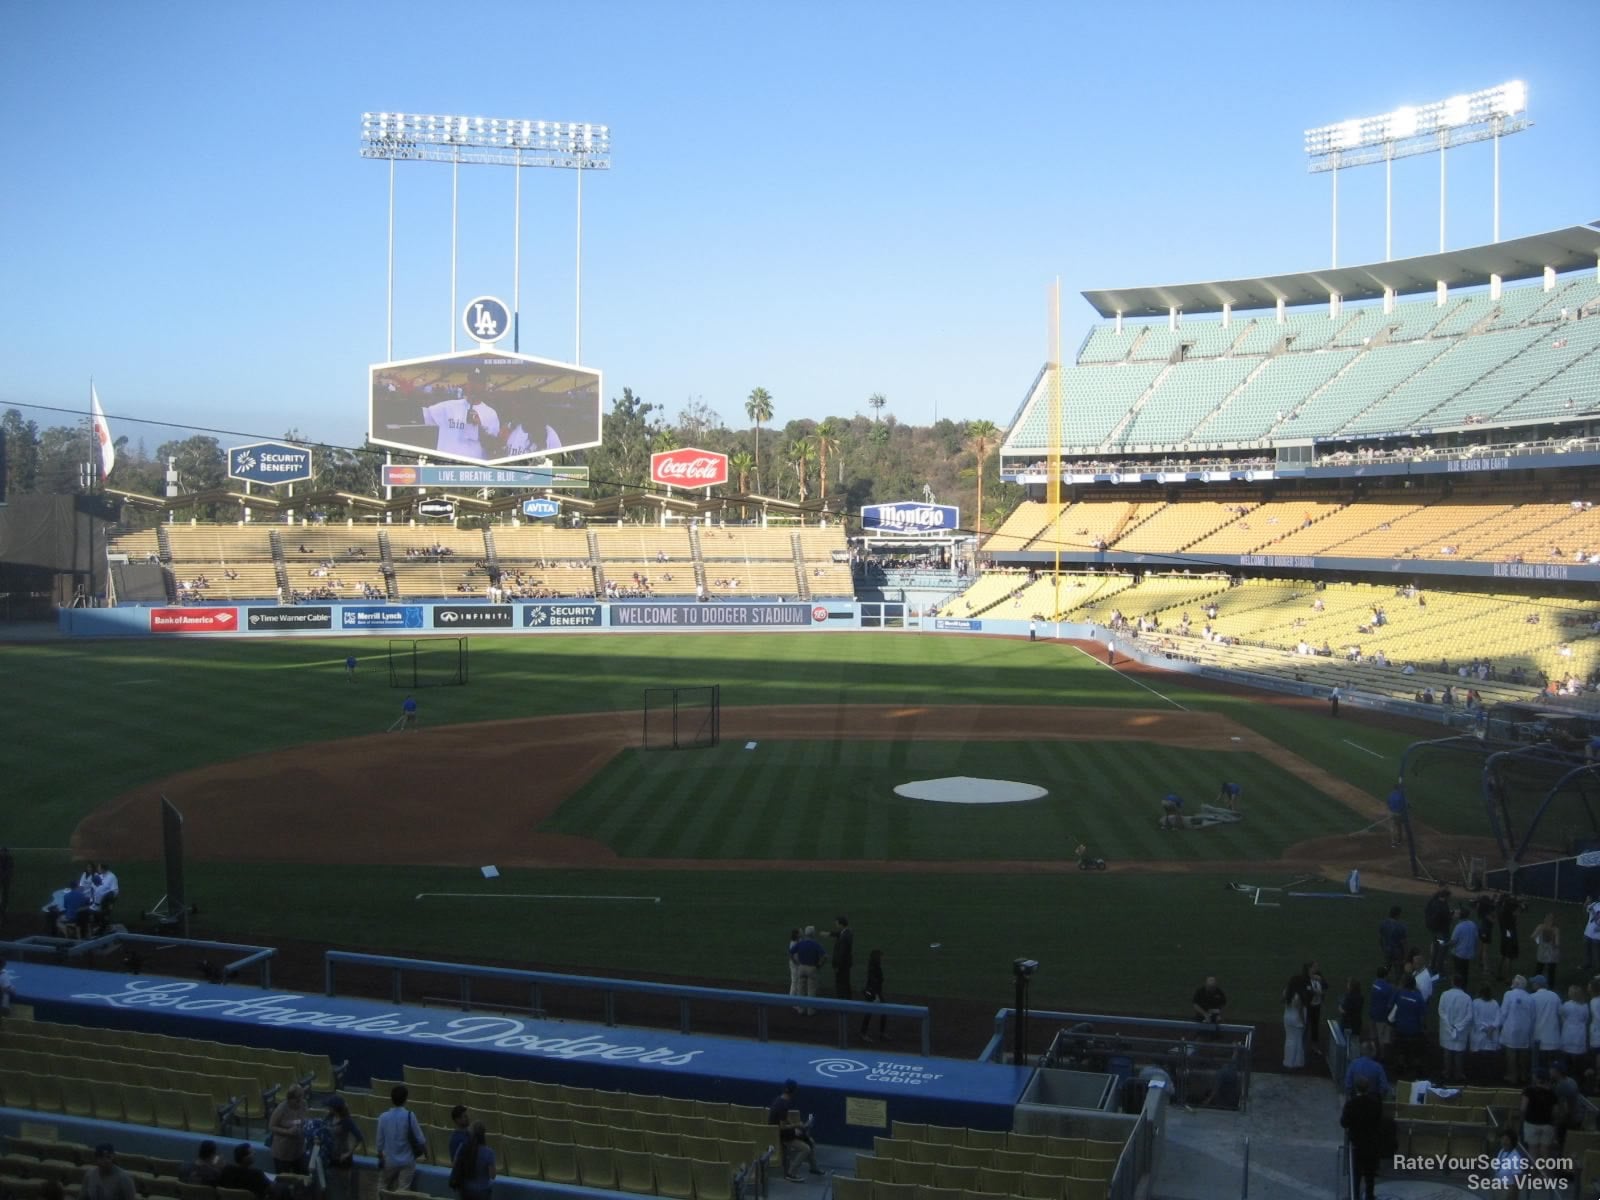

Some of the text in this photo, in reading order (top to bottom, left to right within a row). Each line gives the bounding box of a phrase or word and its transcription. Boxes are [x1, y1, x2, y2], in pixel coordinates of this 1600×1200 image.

[474, 303, 499, 335] LA
[1069, 440, 1274, 455] DODGER STADIUM CLUB
[260, 452, 306, 462] SECURITY
[260, 463, 299, 472] BENEFIT
[1461, 458, 1481, 472] HEAVEN
[439, 471, 457, 482] LIVE.
[459, 471, 495, 482] BREATHE.
[527, 503, 555, 513] AVITA
[877, 504, 944, 530] Montejo
[1493, 563, 1568, 579] BLUE HEAVEN ON EARTH
[357, 612, 380, 620] Merrill
[382, 612, 402, 621] Lynch
[460, 612, 509, 620] INFINITI
[550, 606, 597, 616] SECURITY
[618, 607, 803, 624] WELCOME TO DODGER STADIUM
[814, 609, 827, 619] 76
[154, 616, 214, 624] Bank of America
[260, 613, 328, 622] Time Warner Cable
[550, 615, 590, 625] BENEFIT
[72, 980, 705, 1066] Los Angeles Dodgers
[876, 1061, 924, 1072] Time
[865, 1074, 923, 1085] Cable
[871, 1067, 944, 1081] Warner
